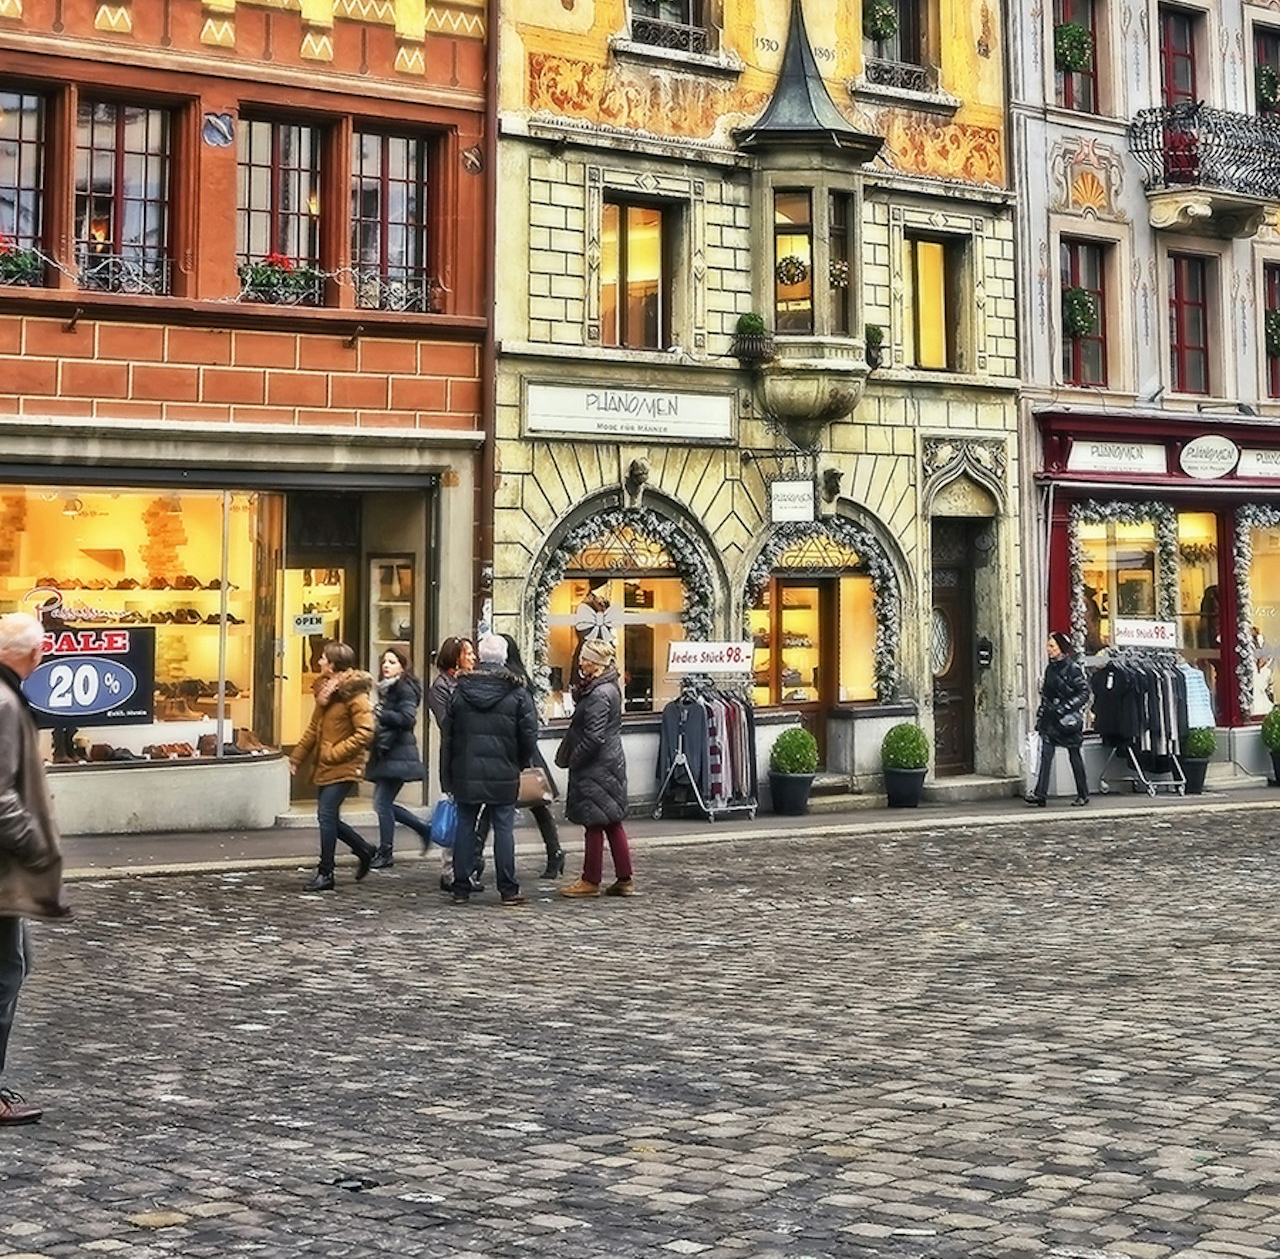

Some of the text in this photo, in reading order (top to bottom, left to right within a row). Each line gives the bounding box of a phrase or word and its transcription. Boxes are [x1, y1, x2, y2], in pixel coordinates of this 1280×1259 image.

[755, 37, 779, 52] 1530
[296, 618, 322, 626] OPEN
[40, 631, 128, 654] SALE
[671, 652, 698, 664] Jedes
[726, 647, 751, 663] 98.-
